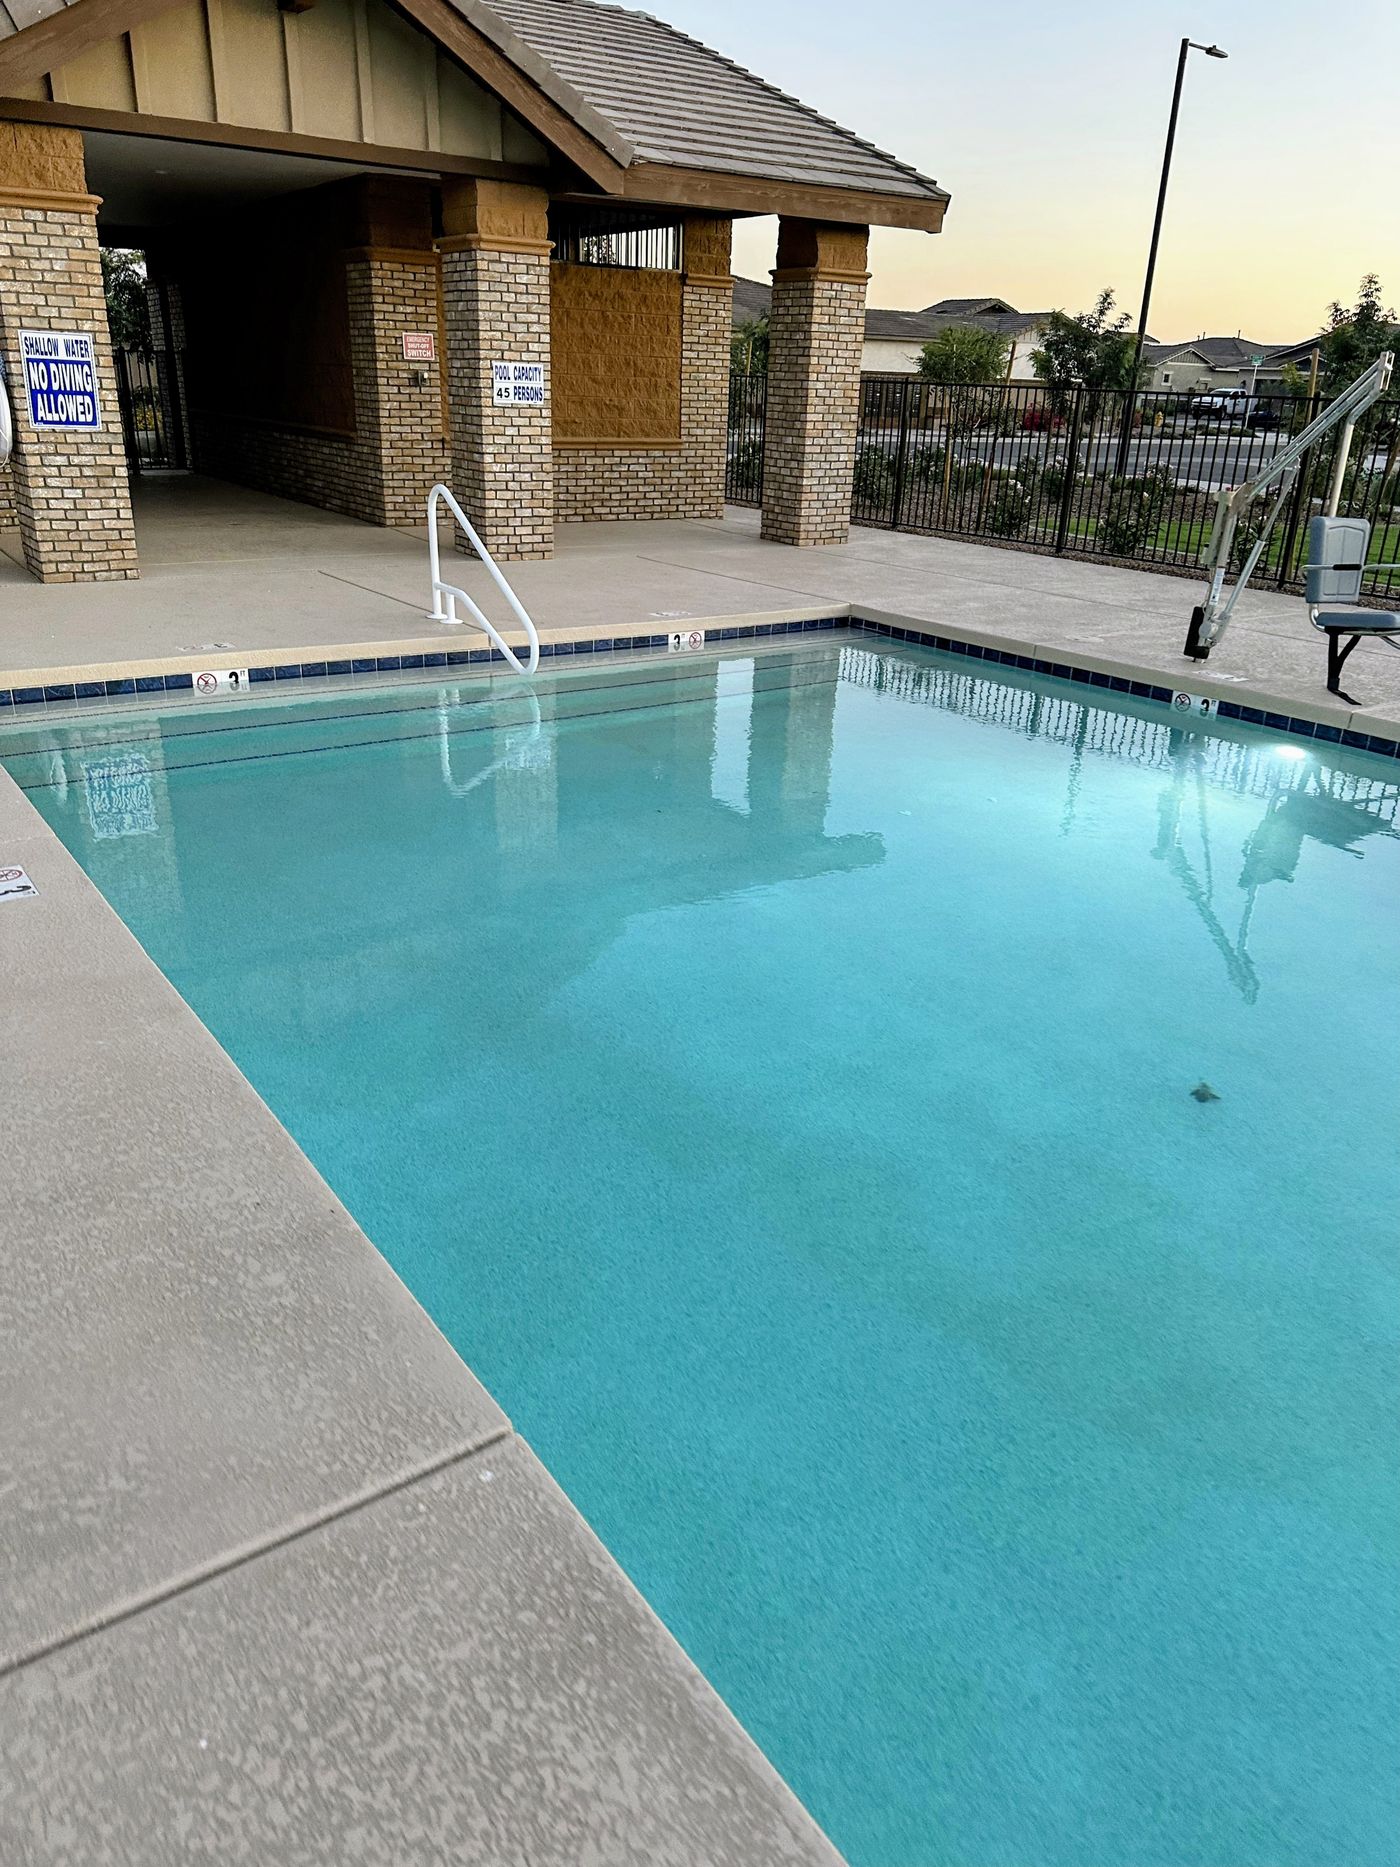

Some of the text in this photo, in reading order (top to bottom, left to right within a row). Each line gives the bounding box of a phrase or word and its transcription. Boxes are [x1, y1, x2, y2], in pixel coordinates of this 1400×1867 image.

[24, 336, 90, 358] SHALLOW WATER
[407, 349, 431, 357] SWITCH
[28, 361, 93, 392] NO DIVING
[495, 364, 542, 382] POOL CAPACITY
[496, 385, 543, 401] 45 PERSONS
[37, 393, 94, 422] ALLOWED
